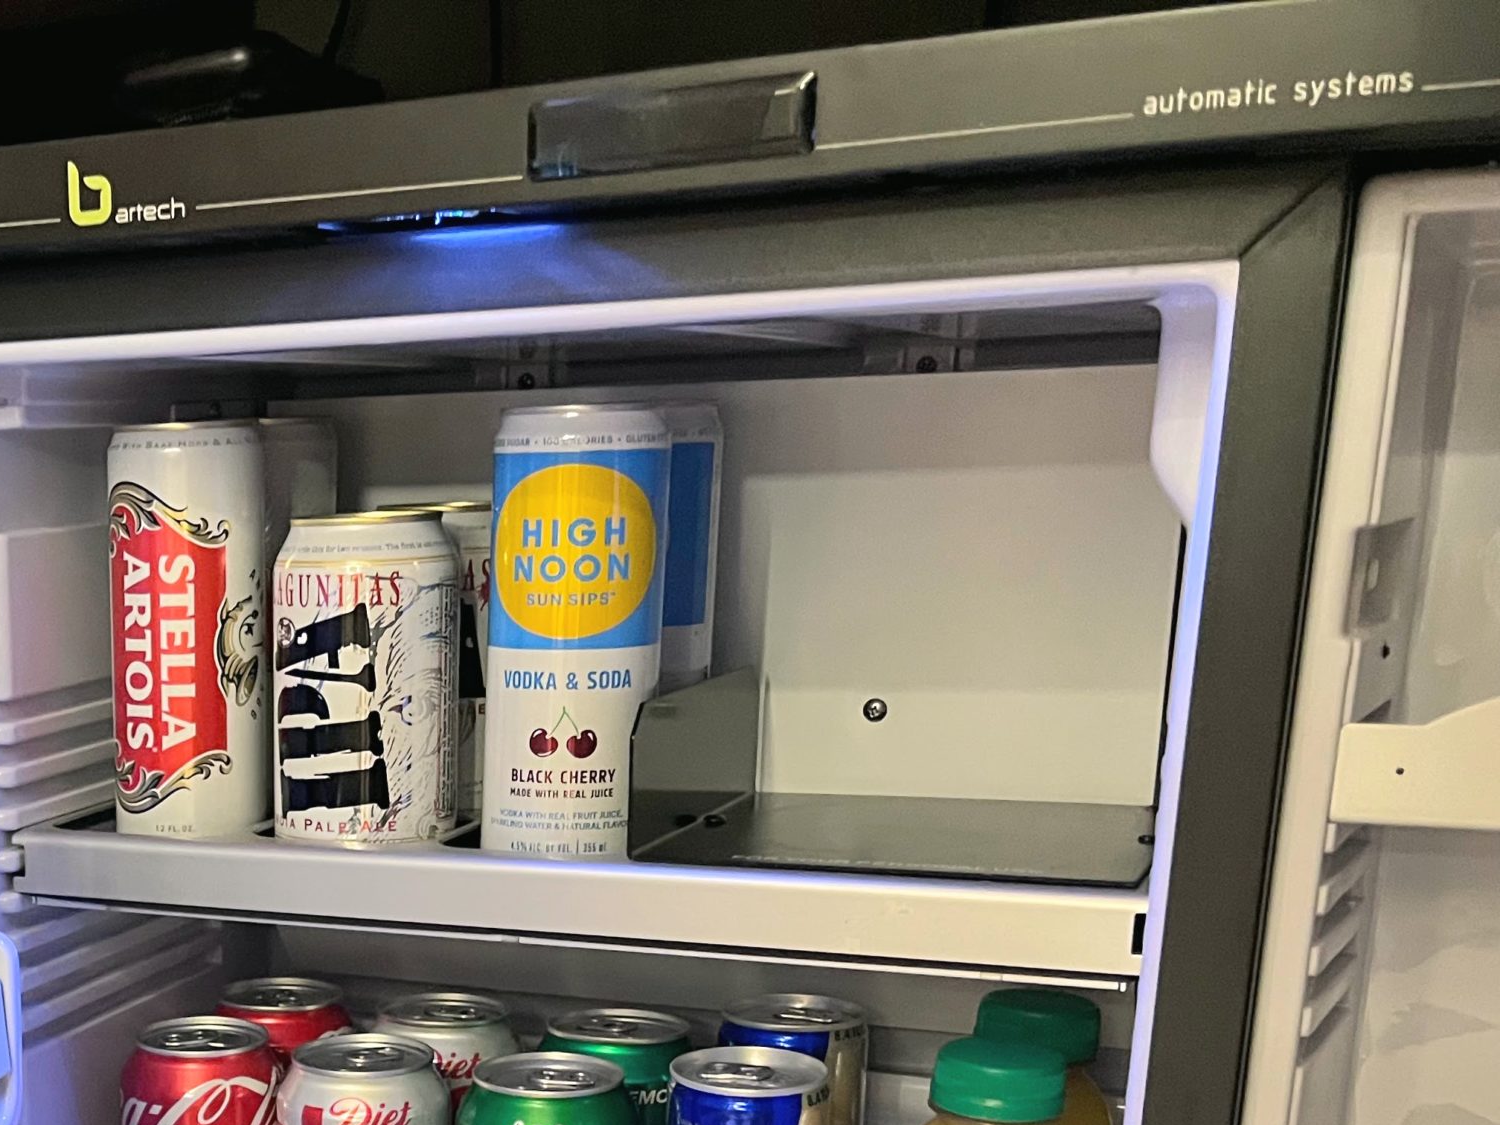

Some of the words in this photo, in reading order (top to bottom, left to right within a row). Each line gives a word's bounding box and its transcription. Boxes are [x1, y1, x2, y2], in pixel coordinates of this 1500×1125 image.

[1143, 79, 1277, 116] automatic
[1293, 70, 1414, 107] systems
[522, 517, 627, 548] HIGH
[514, 553, 630, 583] NOON
[527, 592, 562, 606] SUN
[122, 551, 156, 751] ARTOIS
[158, 553, 197, 752] STELLA
[504, 670, 557, 690] VODKA
[566, 672, 579, 690] &
[587, 669, 632, 690] SODA
[511, 768, 553, 784] BLACK
[560, 768, 616, 785] CHERRY
[510, 787, 531, 797] MADE
[535, 789, 559, 799] WITH
[564, 789, 586, 799] REAL
[590, 788, 614, 799] JUICE
[304, 818, 349, 833] PALE
[360, 819, 398, 833] ALE
